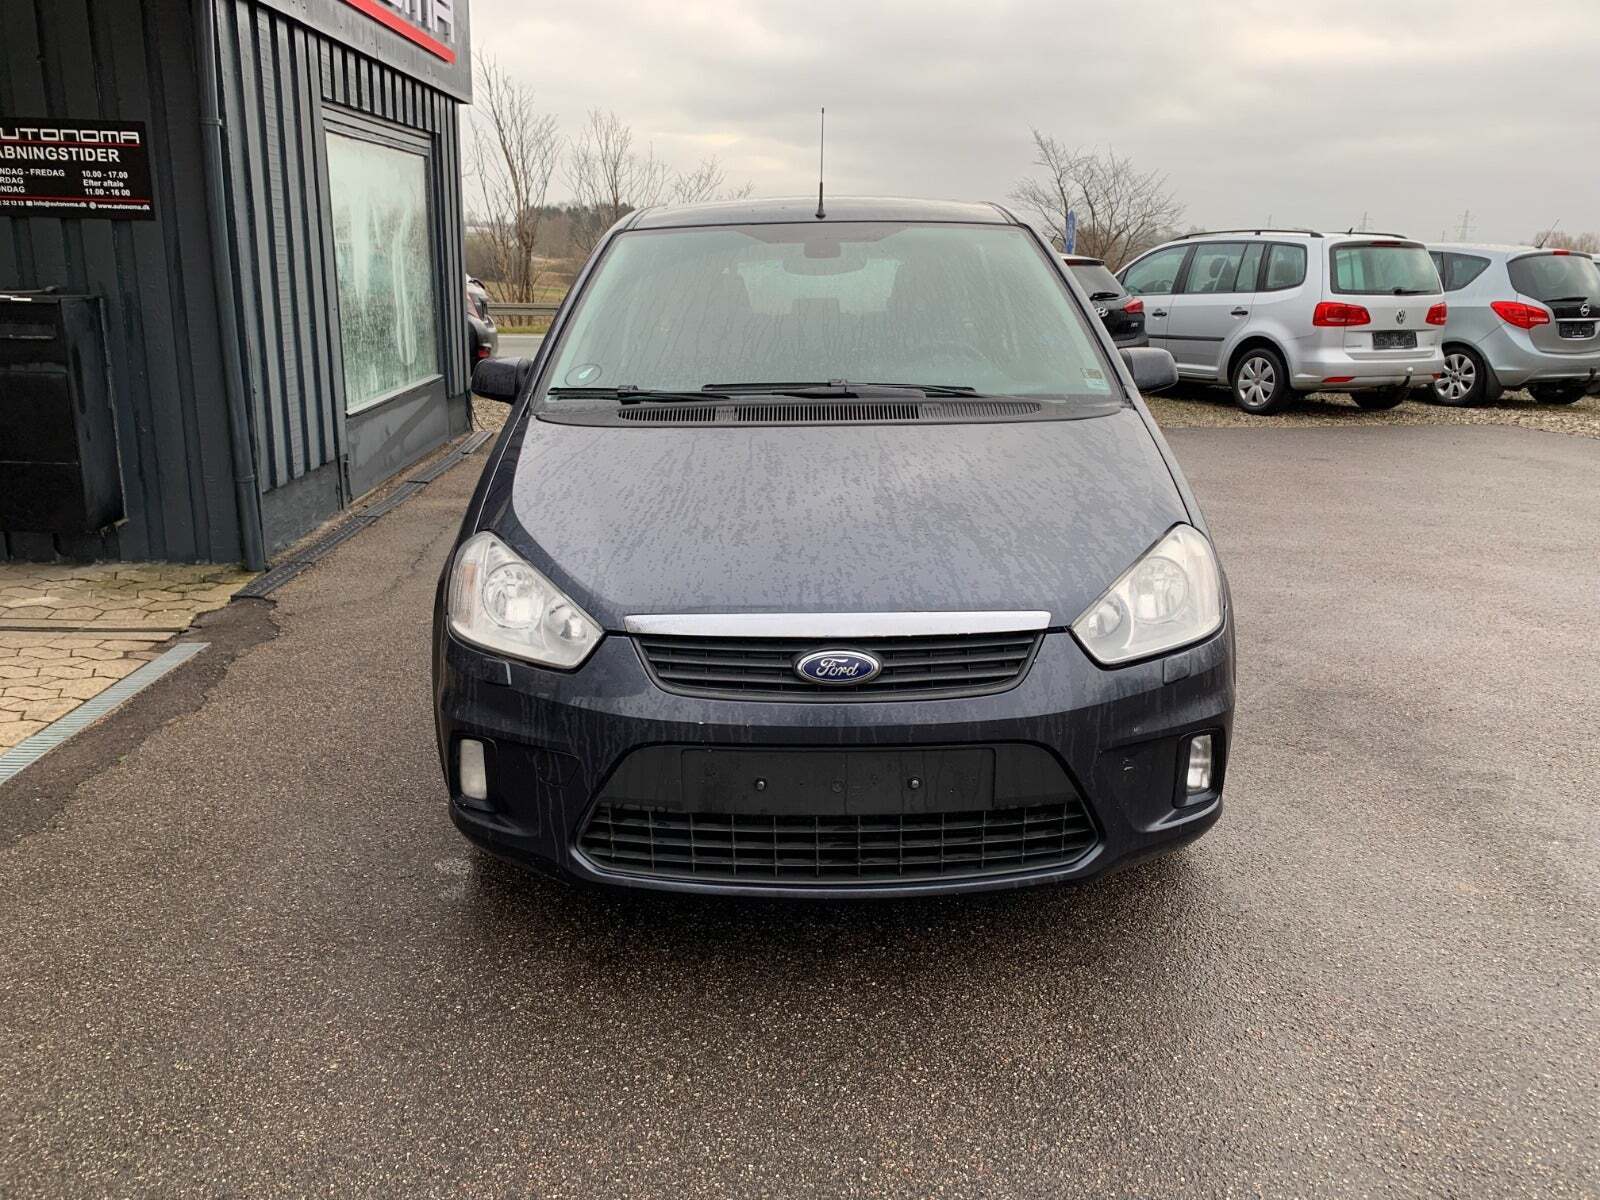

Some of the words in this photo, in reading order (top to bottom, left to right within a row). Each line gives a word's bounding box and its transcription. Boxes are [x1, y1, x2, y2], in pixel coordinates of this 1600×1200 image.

[30, 168, 65, 177] FREDAG
[81, 170, 102, 178] 10.00
[816, 658, 859, 676] Ford
